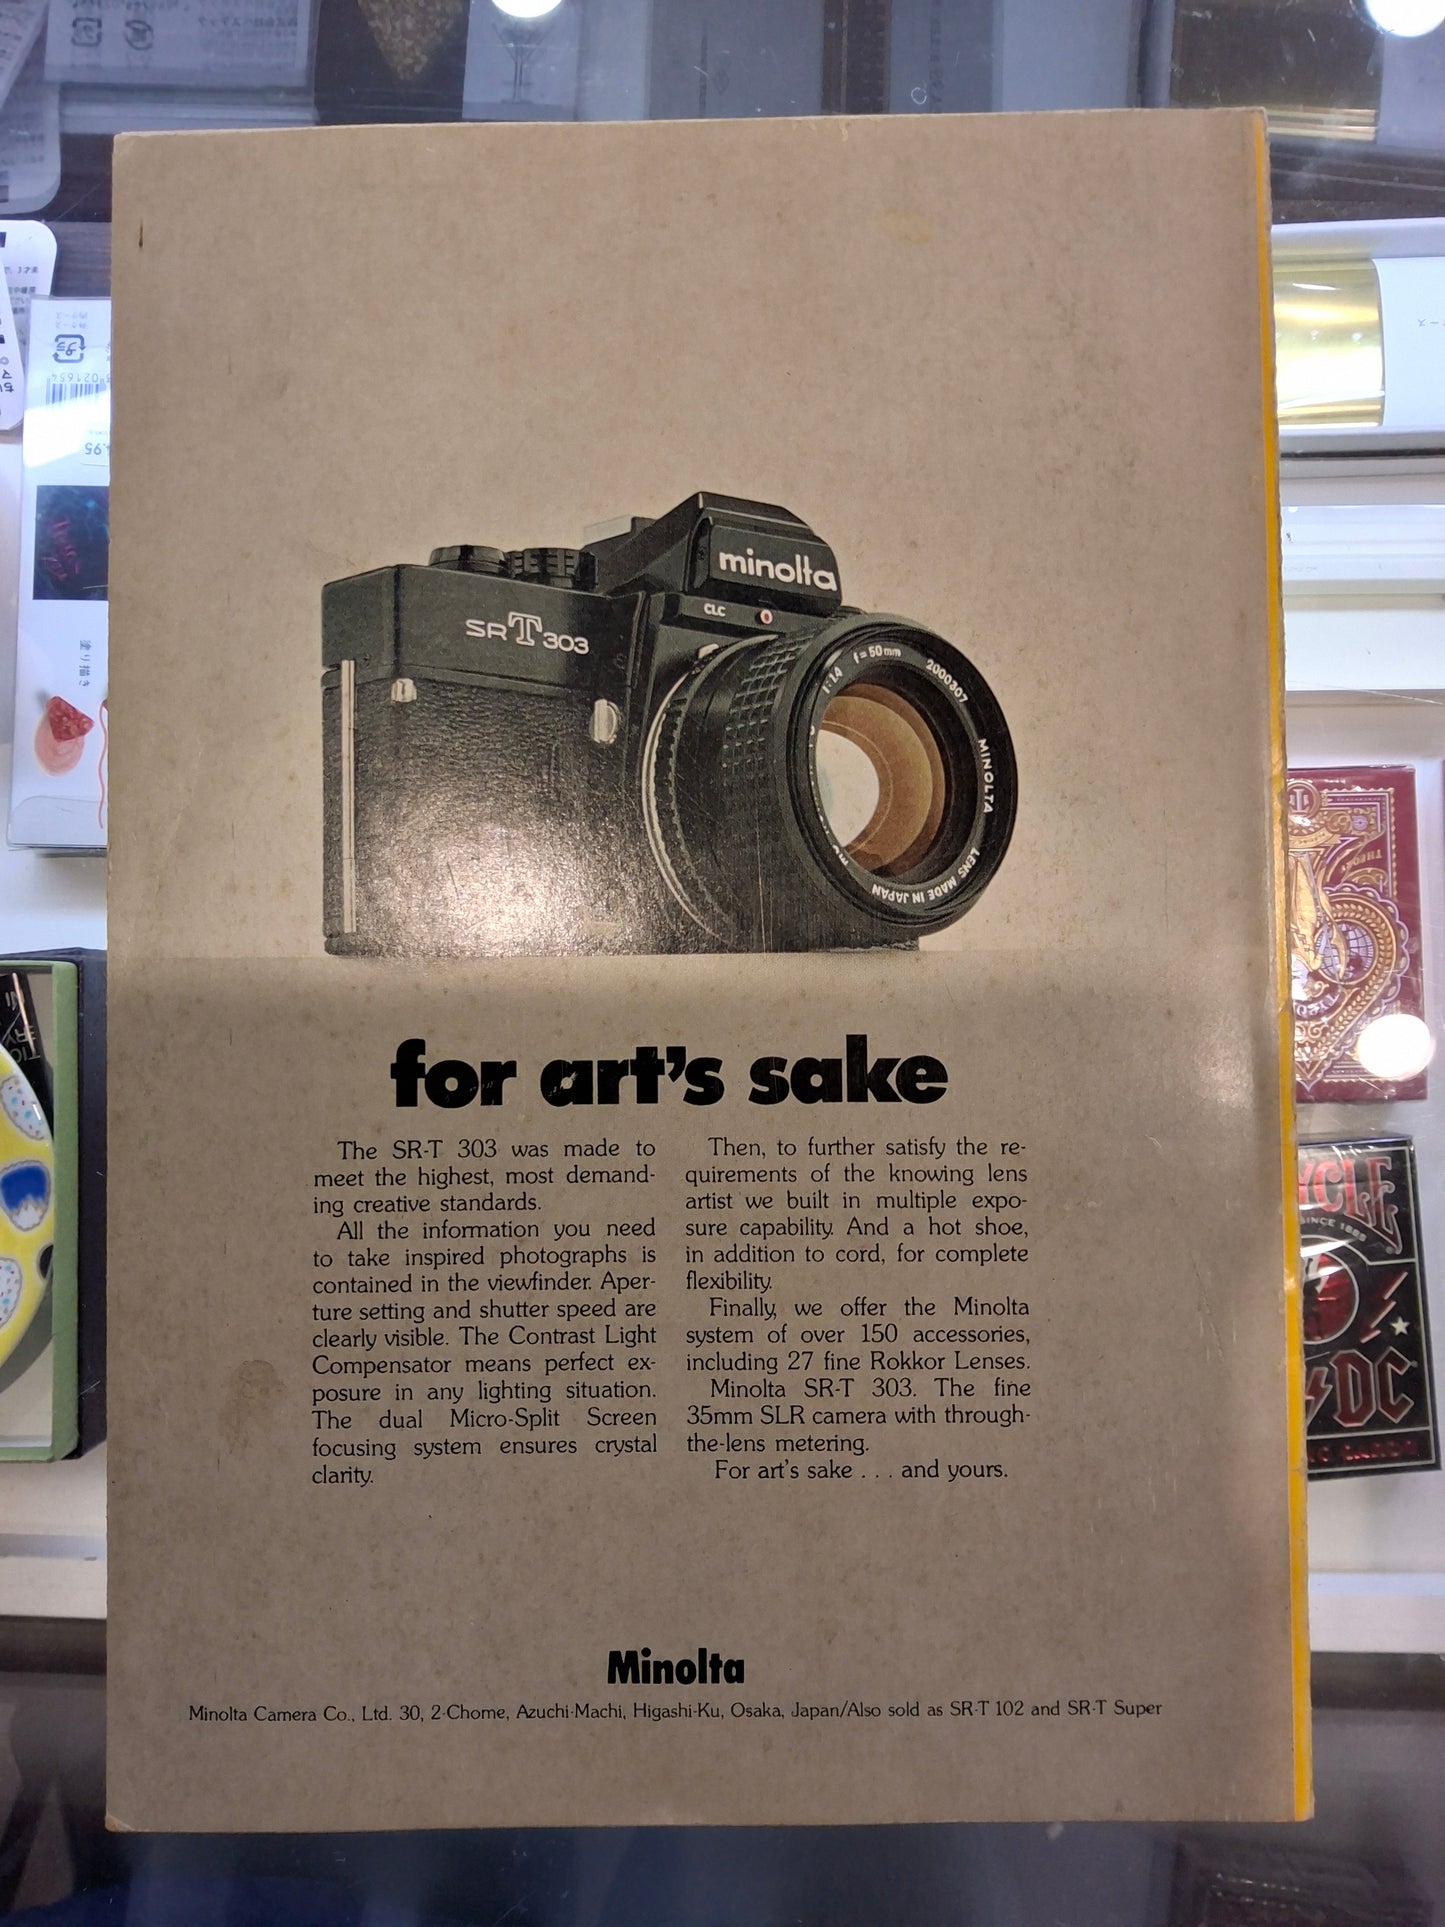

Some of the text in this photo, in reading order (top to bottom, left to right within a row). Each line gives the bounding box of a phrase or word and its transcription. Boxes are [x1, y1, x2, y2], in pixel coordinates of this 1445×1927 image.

[719, 548, 838, 592] minolta
[704, 603, 726, 618] CLC
[925, 658, 969, 704] 2000307
[871, 738, 994, 904] MINOLTA LENS MADE IN JAPAN
[390, 1034, 949, 1109] for art's sake
[336, 1137, 656, 1161] The SR-T 303 was made to
[707, 1135, 1027, 1161] Then, to further satisfy the re-
[313, 1163, 656, 1190] meet the highest, most demand-
[685, 1162, 1028, 1188] quirements of the knowing lens
[313, 1190, 542, 1218] ing creative standards.
[685, 1188, 1028, 1214] artist we built in multiple expo-
[336, 1216, 656, 1242] All the information you need
[685, 1215, 1029, 1241] sure capability. And a hot shoe,
[312, 1243, 657, 1271] to take inspired photographs is
[685, 1242, 1029, 1267] in addition to cord, for complete
[312, 1270, 656, 1295] contained in the viewfinder. Aper-
[685, 1269, 773, 1295] flexibility.
[311, 1297, 657, 1324] ture setting and shutter speed are
[709, 1295, 1030, 1322] Finally, we offer the Minolta
[312, 1323, 657, 1352] clearly visible. The Contrast Light
[685, 1322, 1030, 1349] system of over 150 accessories,
[311, 1350, 657, 1379] Compensator means perfect ex-
[686, 1349, 1031, 1376] including 27 fine Rokkor Lenses.
[311, 1379, 657, 1407] posure in any lighting situation.
[710, 1376, 1032, 1399] Minolta SR-T 303. The fine
[311, 1406, 657, 1432] The dual Micro-Split Screen
[686, 1403, 1031, 1428] 35mm SLR camera with through-
[312, 1432, 657, 1461] focusing system ensures crystal
[686, 1431, 870, 1457] the-lens metering.
[311, 1463, 374, 1488] clarity.
[714, 1457, 1009, 1483] For art's sake and yours.
[607, 1647, 745, 1685] Minolta
[188, 1704, 248, 1722] Minolta
[253, 1705, 318, 1722] Camera
[323, 1705, 356, 1723] Co.,
[361, 1704, 393, 1722] Ltd.
[399, 1704, 424, 1723] 30,
[730, 1701, 785, 1720] Osaka,
[887, 1700, 921, 1718] sold
[926, 1705, 944, 1717] as
[995, 1699, 1025, 1717] 102
[1030, 1699, 1061, 1717] and
[1113, 1698, 1163, 1719] Super
